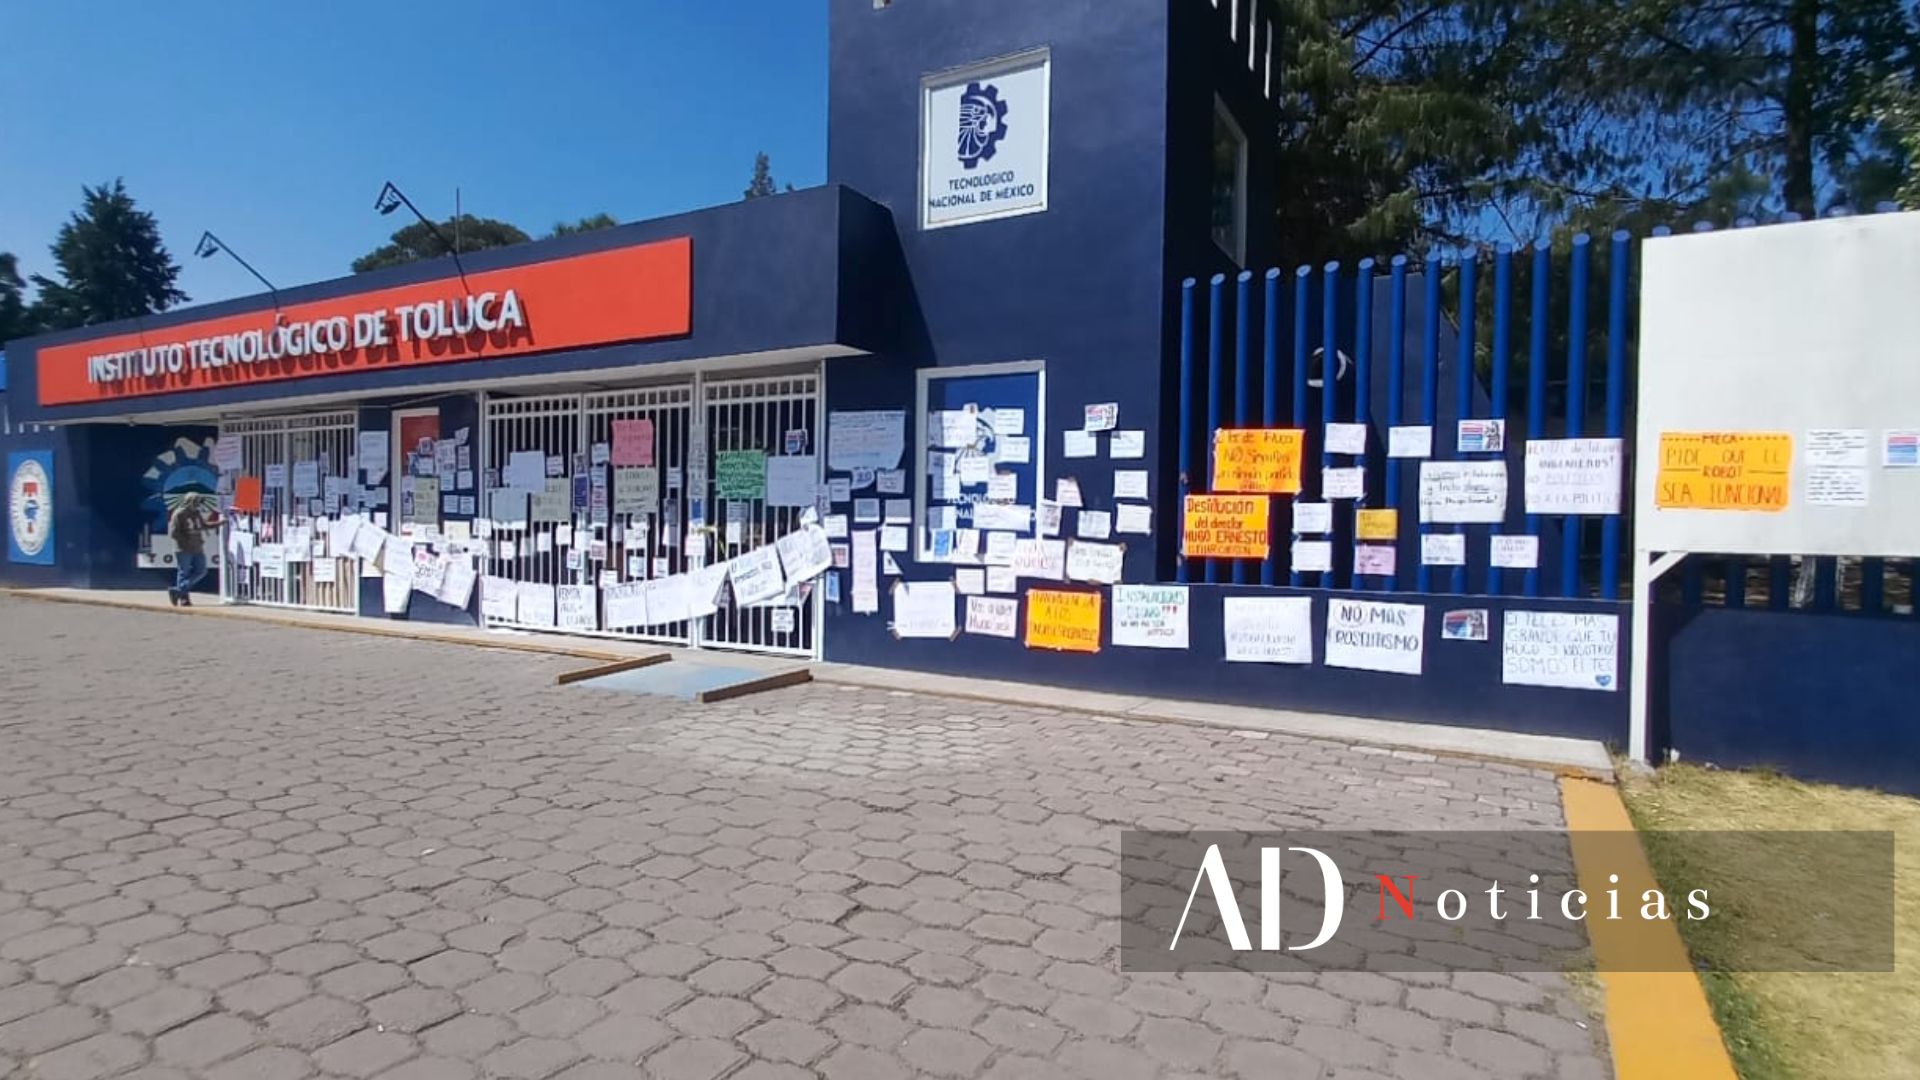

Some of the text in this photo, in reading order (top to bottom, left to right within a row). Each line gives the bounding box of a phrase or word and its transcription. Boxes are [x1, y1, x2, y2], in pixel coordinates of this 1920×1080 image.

[929, 193, 975, 208] NACIONAL
[980, 190, 992, 202] DE
[88, 343, 185, 384] INSTITUTO
[354, 309, 388, 348] DE
[395, 289, 523, 341] TOLUCA
[1666, 448, 1700, 466] PIDE
[1661, 482, 1693, 504] SEA
[1216, 530, 1267, 545] ERNESTO
[1340, 605, 1362, 622] NO
